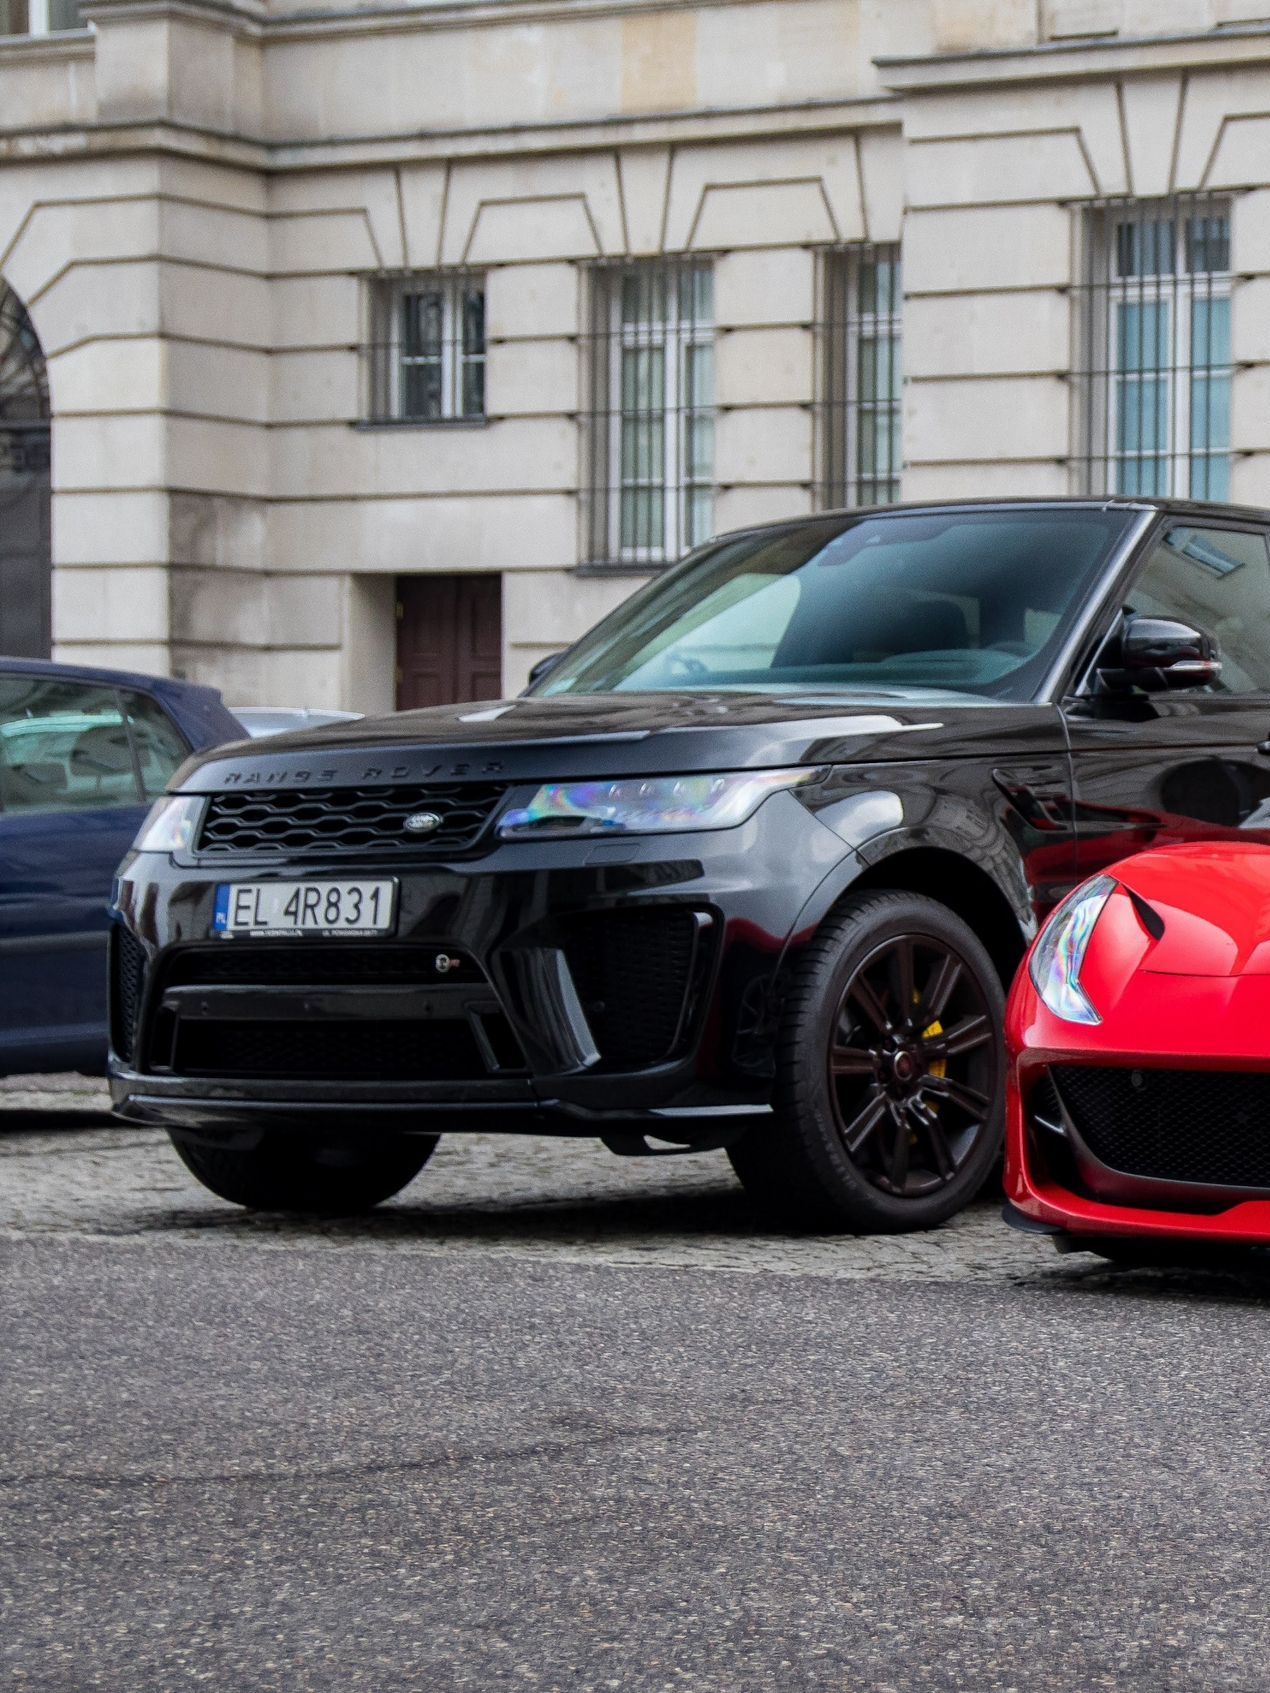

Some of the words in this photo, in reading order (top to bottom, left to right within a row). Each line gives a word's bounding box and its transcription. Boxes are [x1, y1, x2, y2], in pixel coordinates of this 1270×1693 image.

[224, 769, 337, 785] RANGE
[362, 762, 505, 780] ROVER
[234, 888, 268, 926] EL
[283, 886, 380, 926] 4R831
